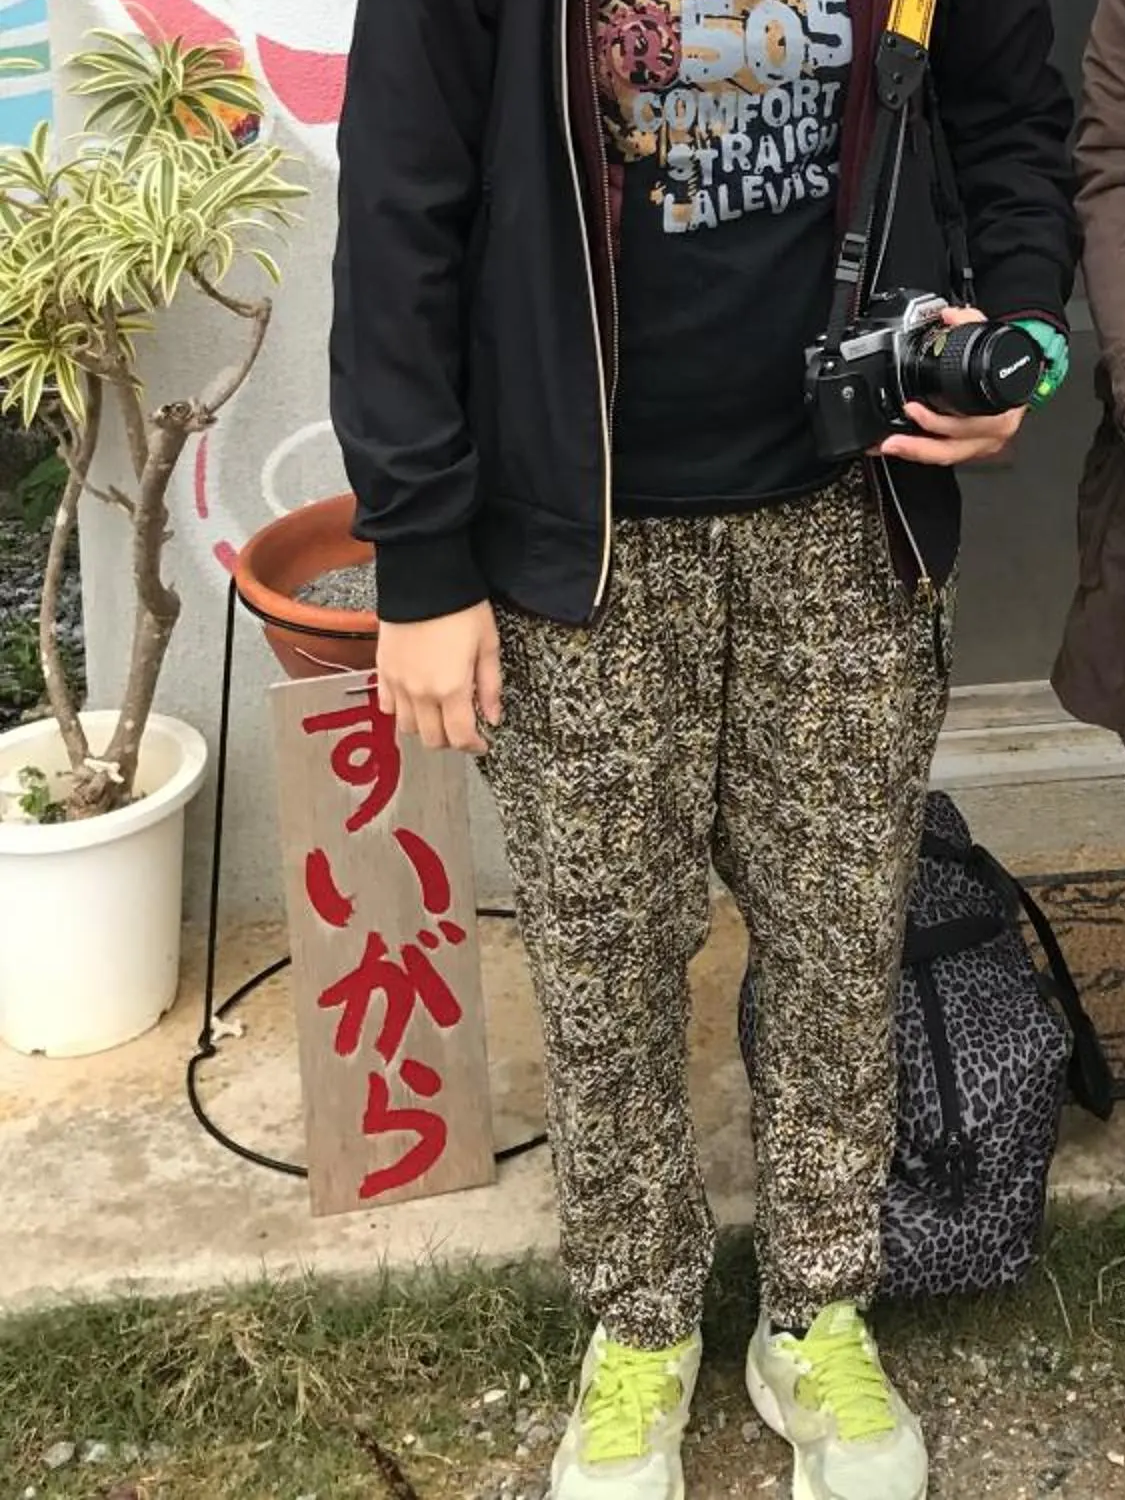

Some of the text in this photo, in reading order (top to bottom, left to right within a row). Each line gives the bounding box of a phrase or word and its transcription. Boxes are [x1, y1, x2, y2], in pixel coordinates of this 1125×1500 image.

[632, 78, 841, 133] COMFORT
[302, 673, 467, 1199] すいがら
